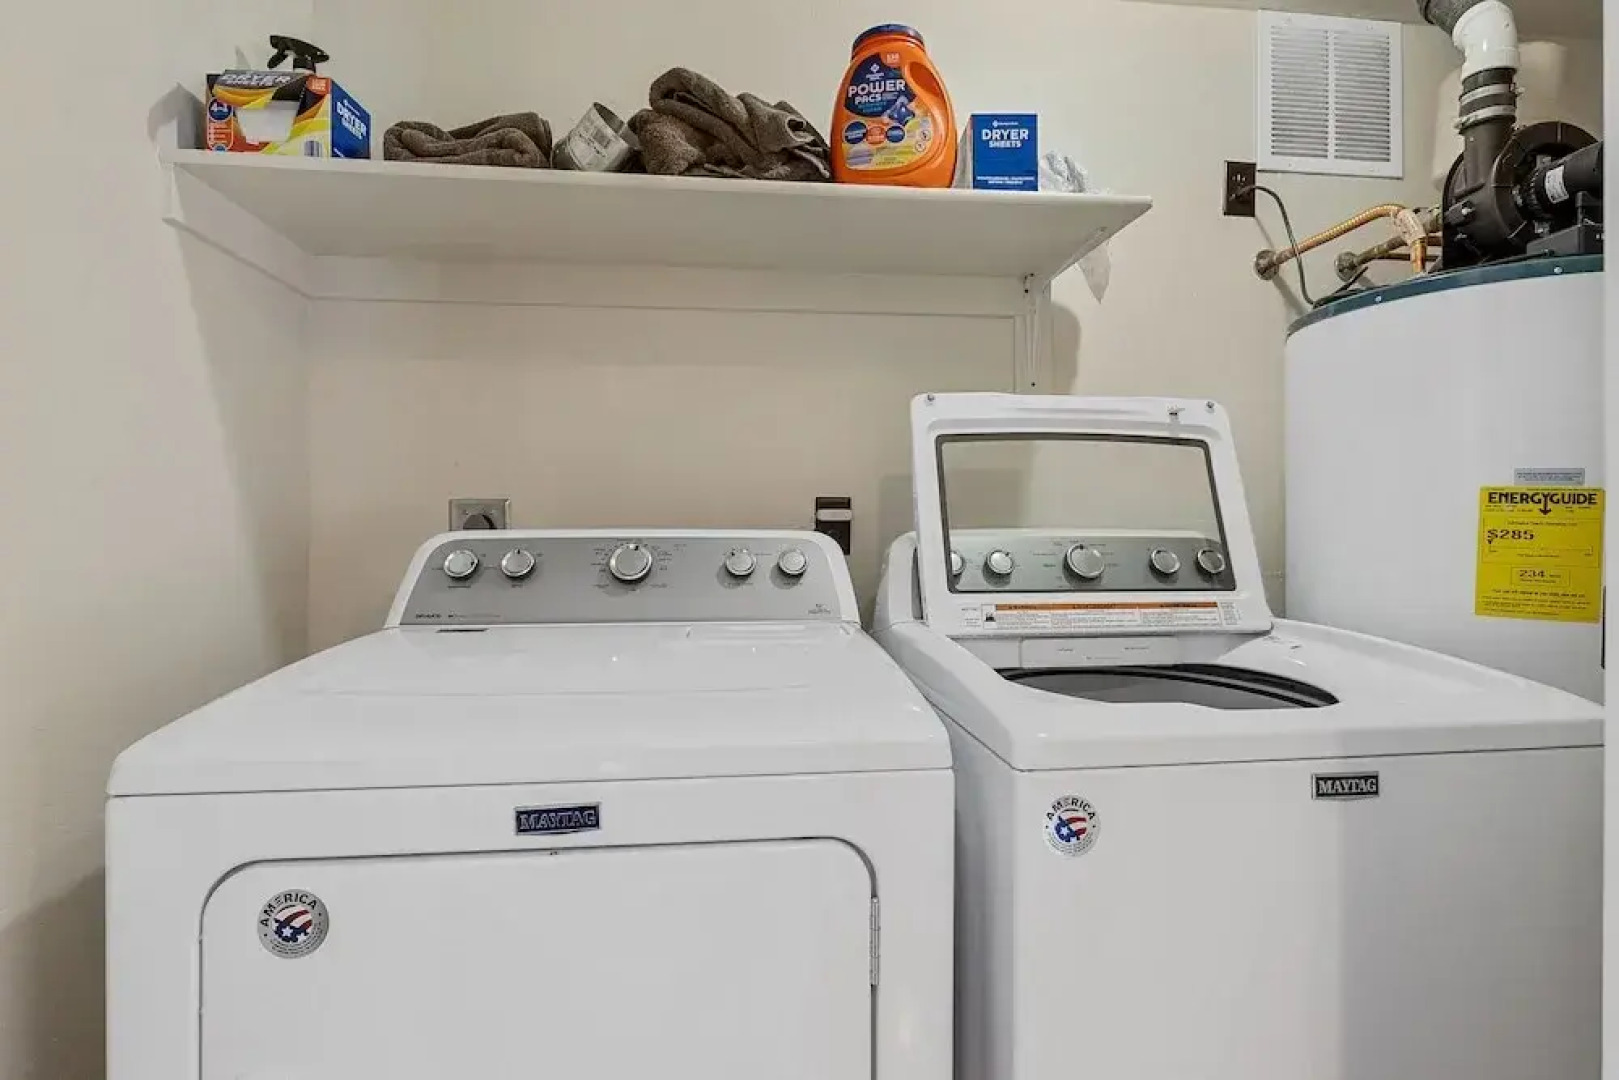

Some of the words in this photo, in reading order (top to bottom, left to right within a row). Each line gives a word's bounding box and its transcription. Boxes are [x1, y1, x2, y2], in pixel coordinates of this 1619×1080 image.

[848, 79, 906, 97] POWER
[854, 94, 882, 105] PACS
[336, 101, 367, 137] DRYER
[981, 129, 1029, 140] DRYER
[988, 140, 1022, 148] SHEETS
[1488, 491, 1598, 506] ENERGYGUIDE
[1487, 528, 1535, 540] $285
[1519, 569, 1546, 578] 234
[1317, 778, 1377, 794] MAYTAG
[1046, 797, 1096, 821] AMERICA
[519, 810, 597, 830] MAYTAG
[260, 892, 317, 927] AMERICA
